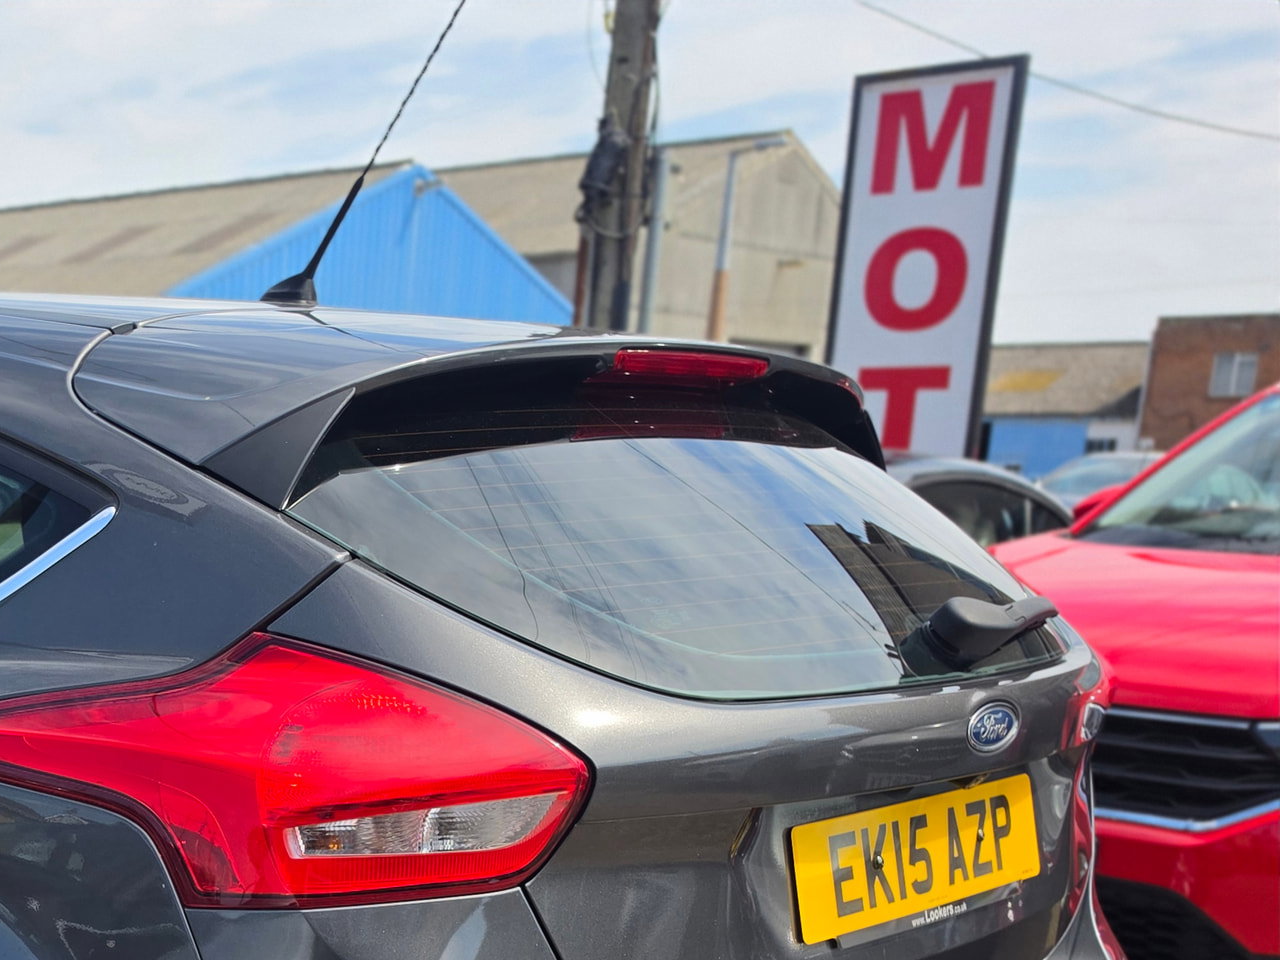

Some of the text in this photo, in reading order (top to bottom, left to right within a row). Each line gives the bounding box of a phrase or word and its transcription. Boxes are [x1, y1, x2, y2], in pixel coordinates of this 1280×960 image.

[858, 80, 997, 450] MOT
[828, 794, 1011, 918] EK15 AZP
